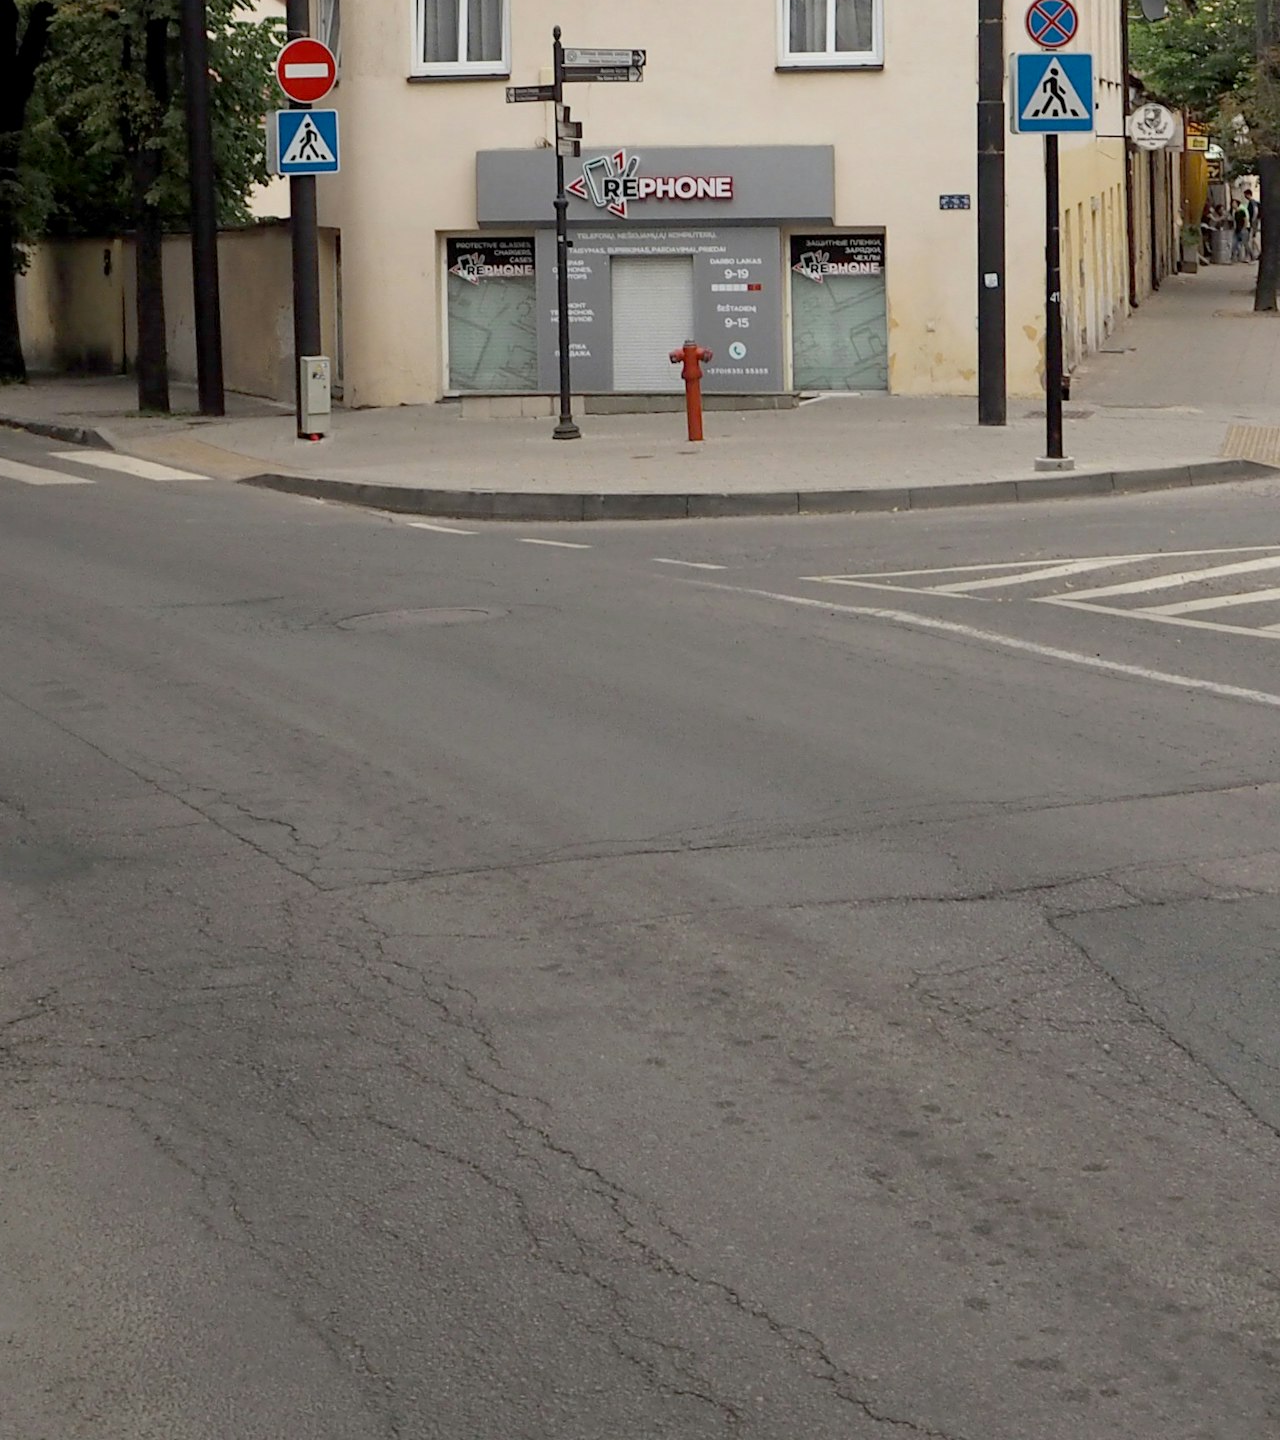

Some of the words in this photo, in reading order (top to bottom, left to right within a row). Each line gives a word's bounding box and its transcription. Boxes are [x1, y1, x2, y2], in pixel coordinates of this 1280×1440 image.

[603, 176, 733, 200] REPHONE
[467, 264, 534, 276] REPHONE
[724, 268, 749, 279] 9-19
[810, 262, 880, 274] REPHONE
[724, 317, 749, 328] 9-15
